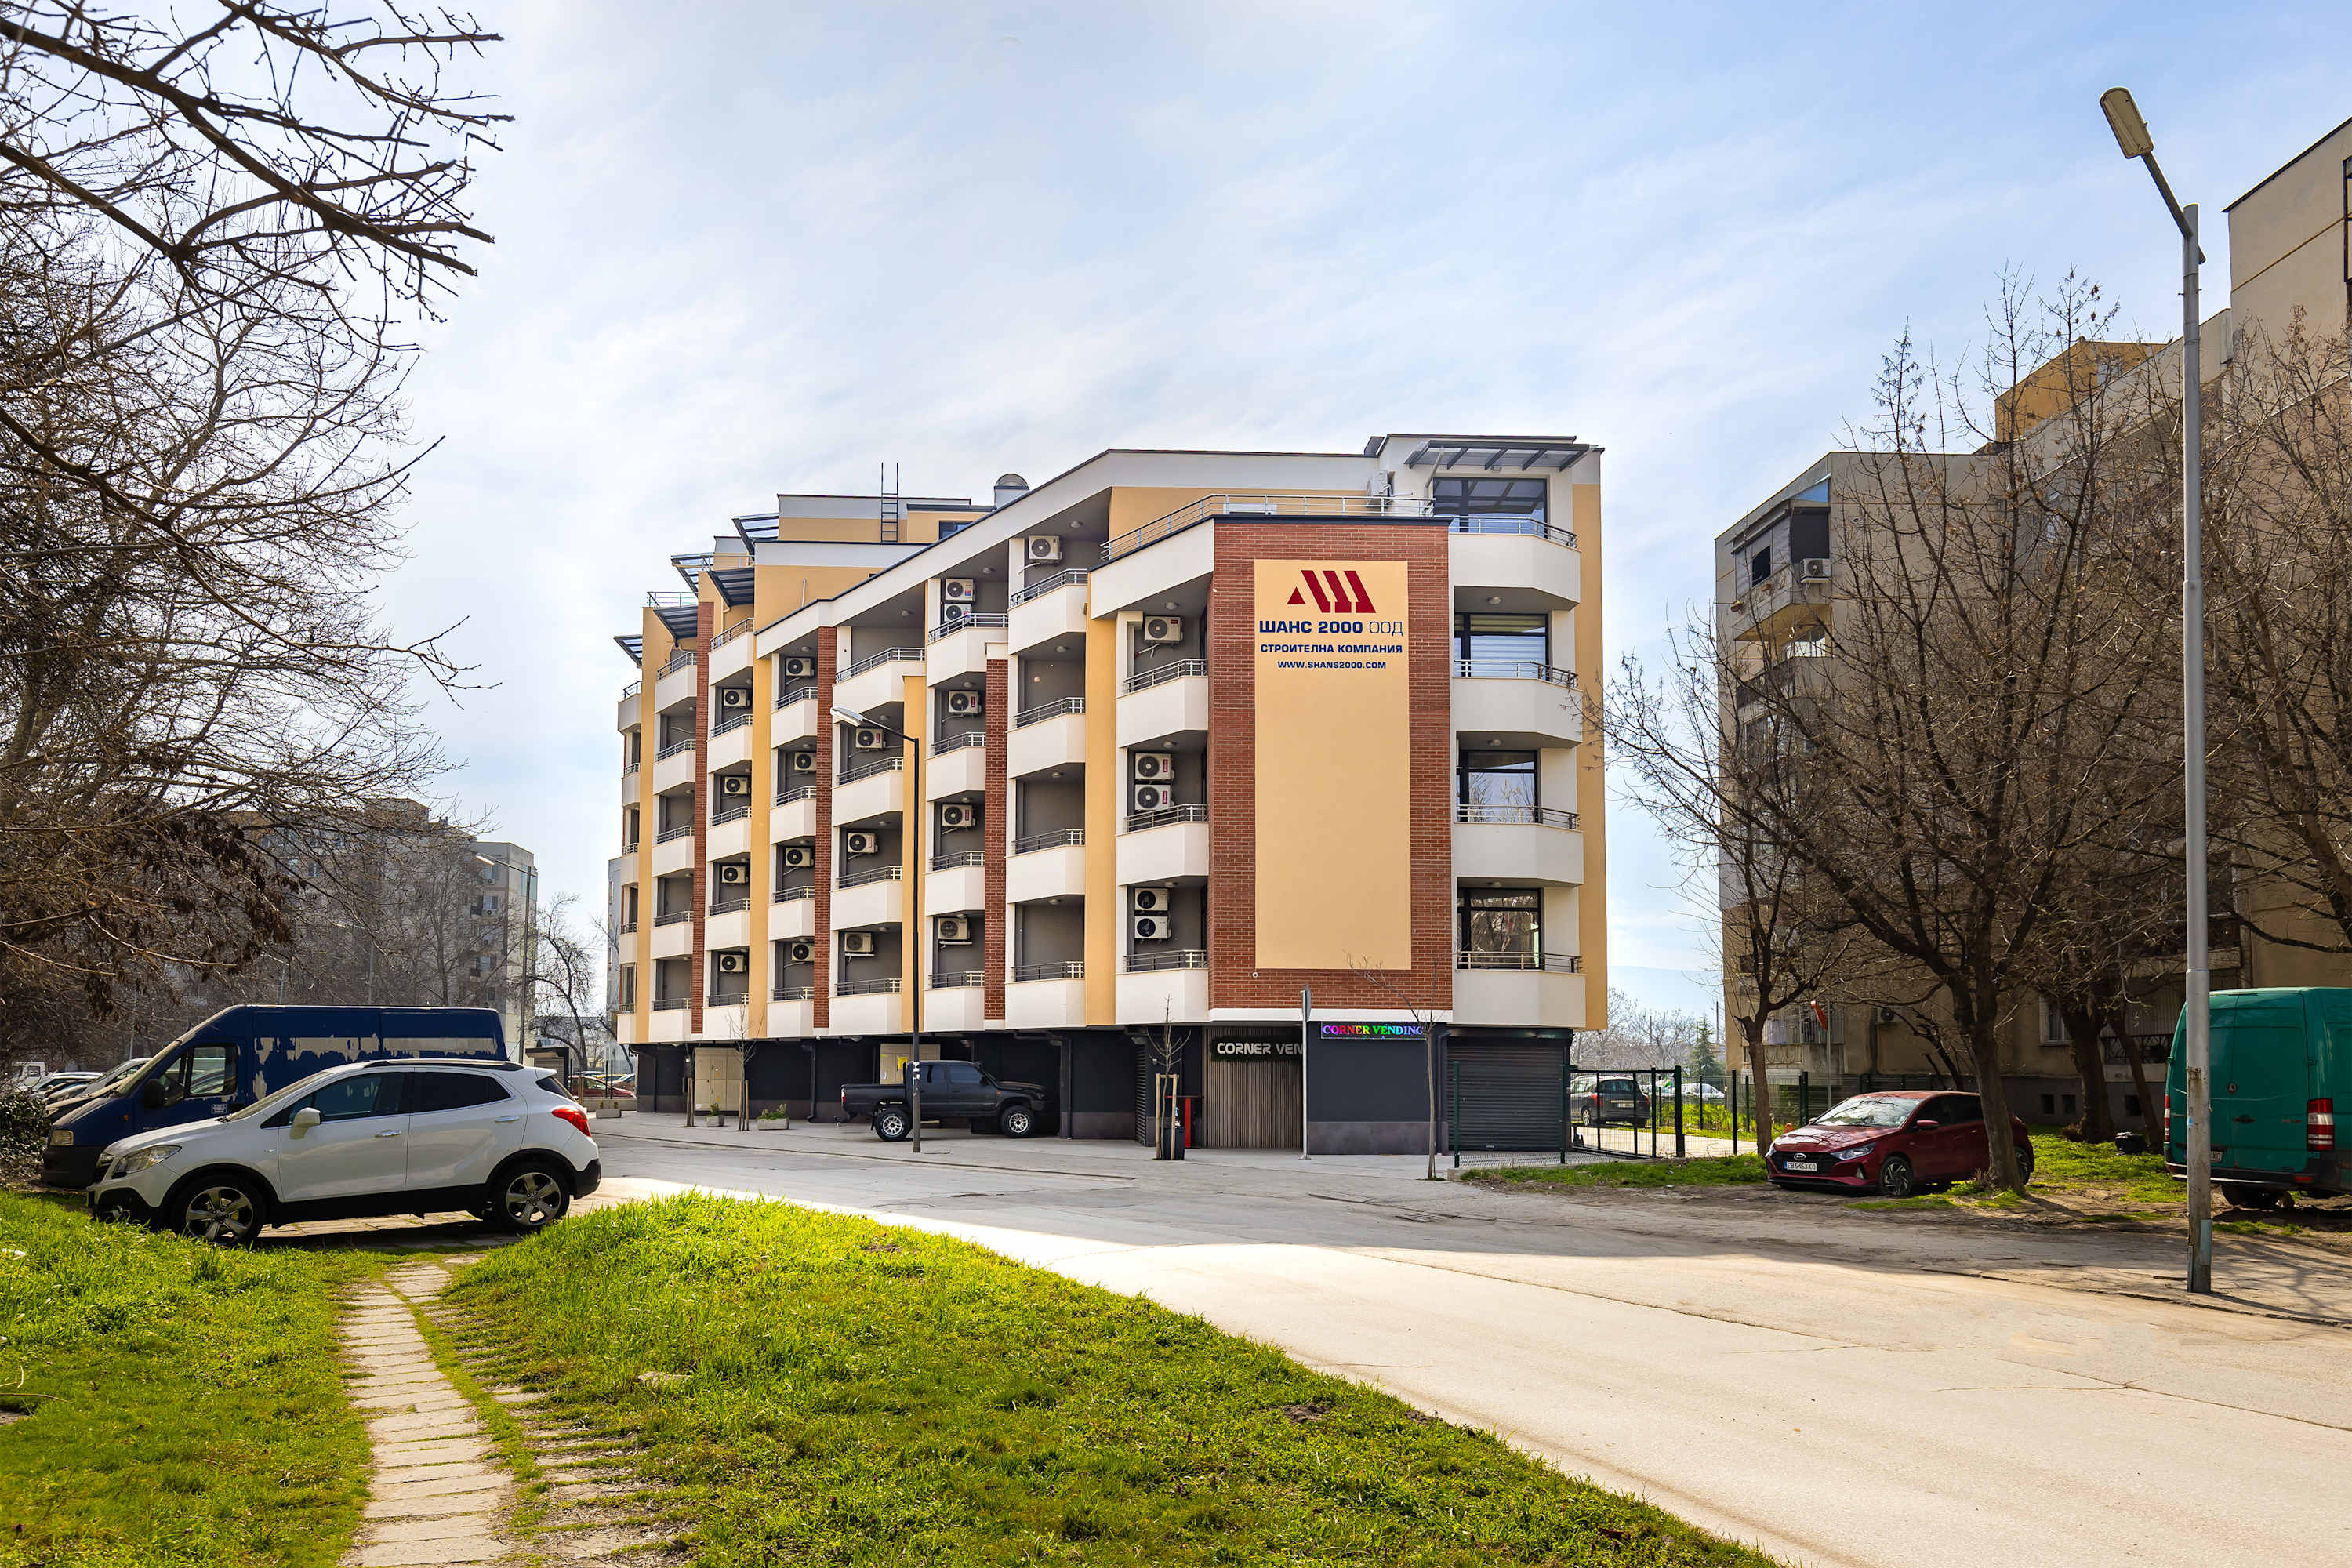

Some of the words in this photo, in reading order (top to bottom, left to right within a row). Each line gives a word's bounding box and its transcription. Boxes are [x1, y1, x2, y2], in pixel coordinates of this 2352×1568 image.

[1259, 620, 1312, 633] ШАНС
[1318, 620, 1363, 634] 2000
[1369, 621, 1403, 637] ООД
[1260, 644, 1334, 654] СТРОИТЕЛНА
[1338, 644, 1403, 654] КОМПАНИЯ
[1323, 1025, 1370, 1035] CORNER
[1372, 1025, 1424, 1036] VENDING
[1217, 1042, 1272, 1054] CORNER
